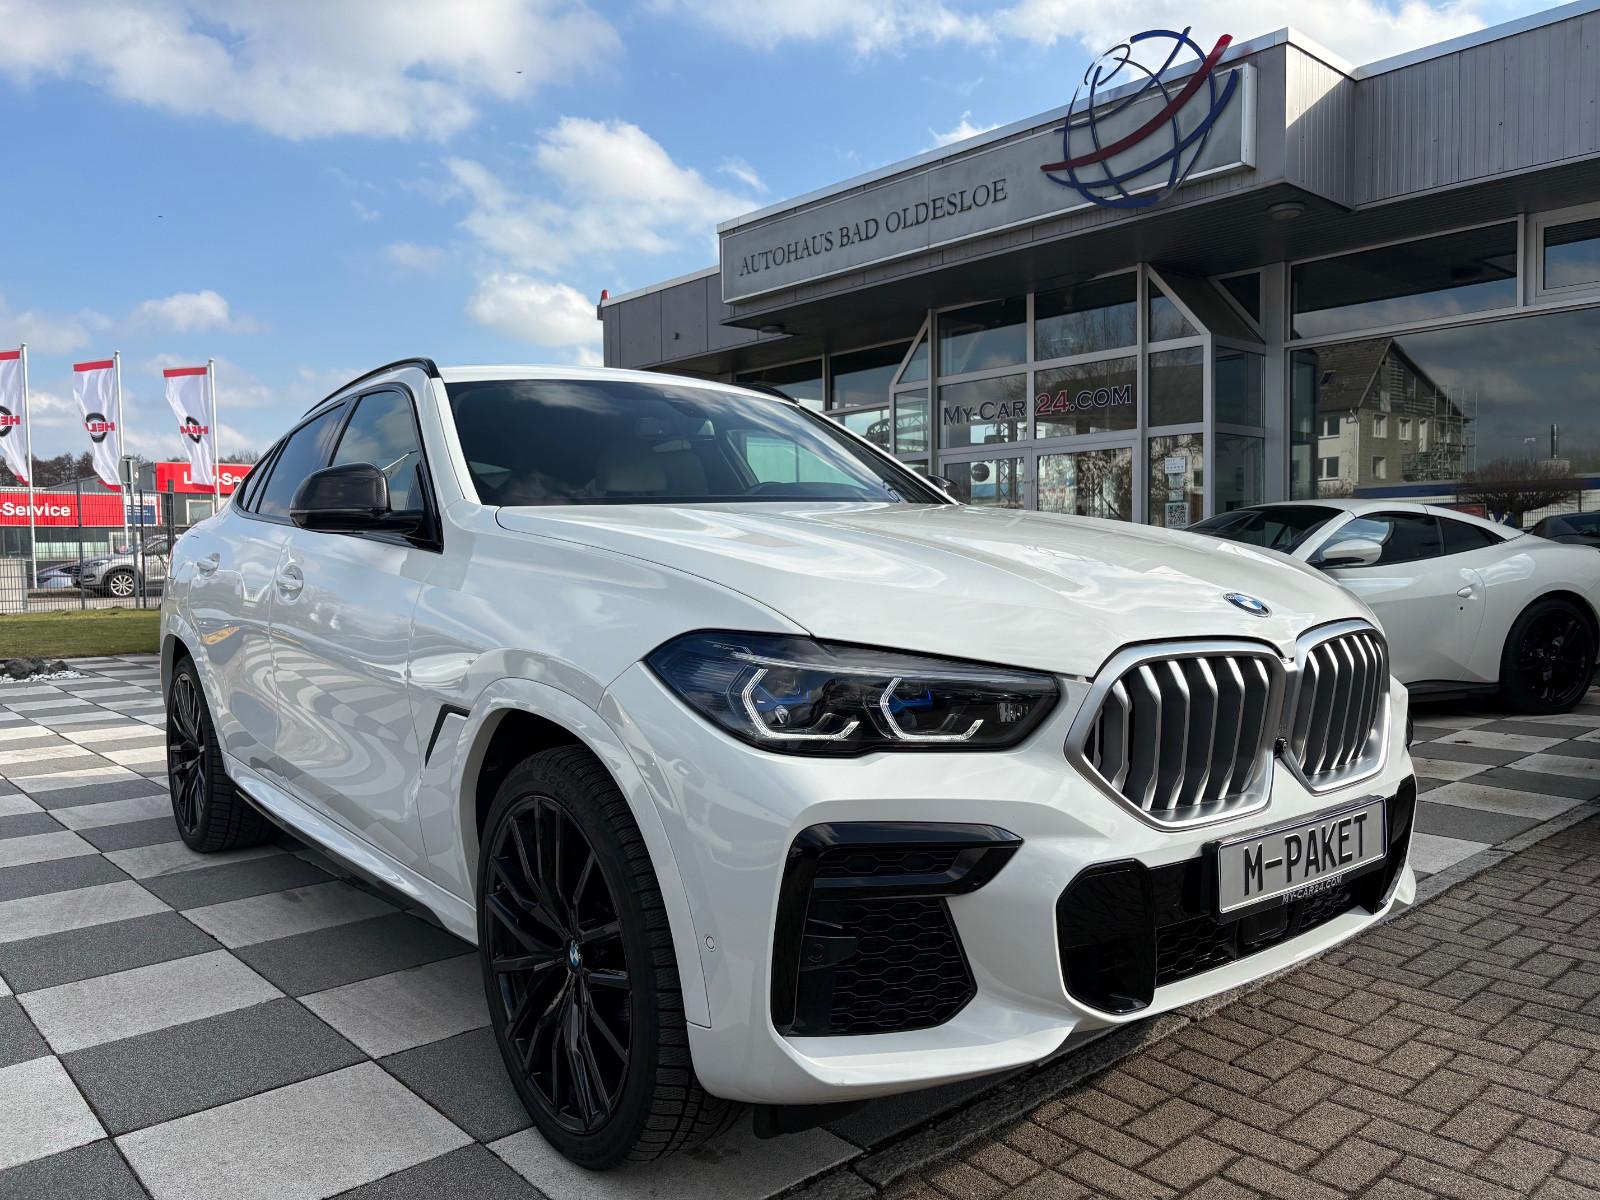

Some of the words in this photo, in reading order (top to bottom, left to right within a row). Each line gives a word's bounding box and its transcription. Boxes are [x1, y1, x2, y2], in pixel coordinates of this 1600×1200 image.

[739, 231, 834, 276] AUTOHAUS
[839, 218, 879, 248] BAD
[885, 178, 1008, 234] OLDESLOE
[1035, 384, 1132, 417] 24.COM
[1243, 811, 1368, 896] M-PAKET
